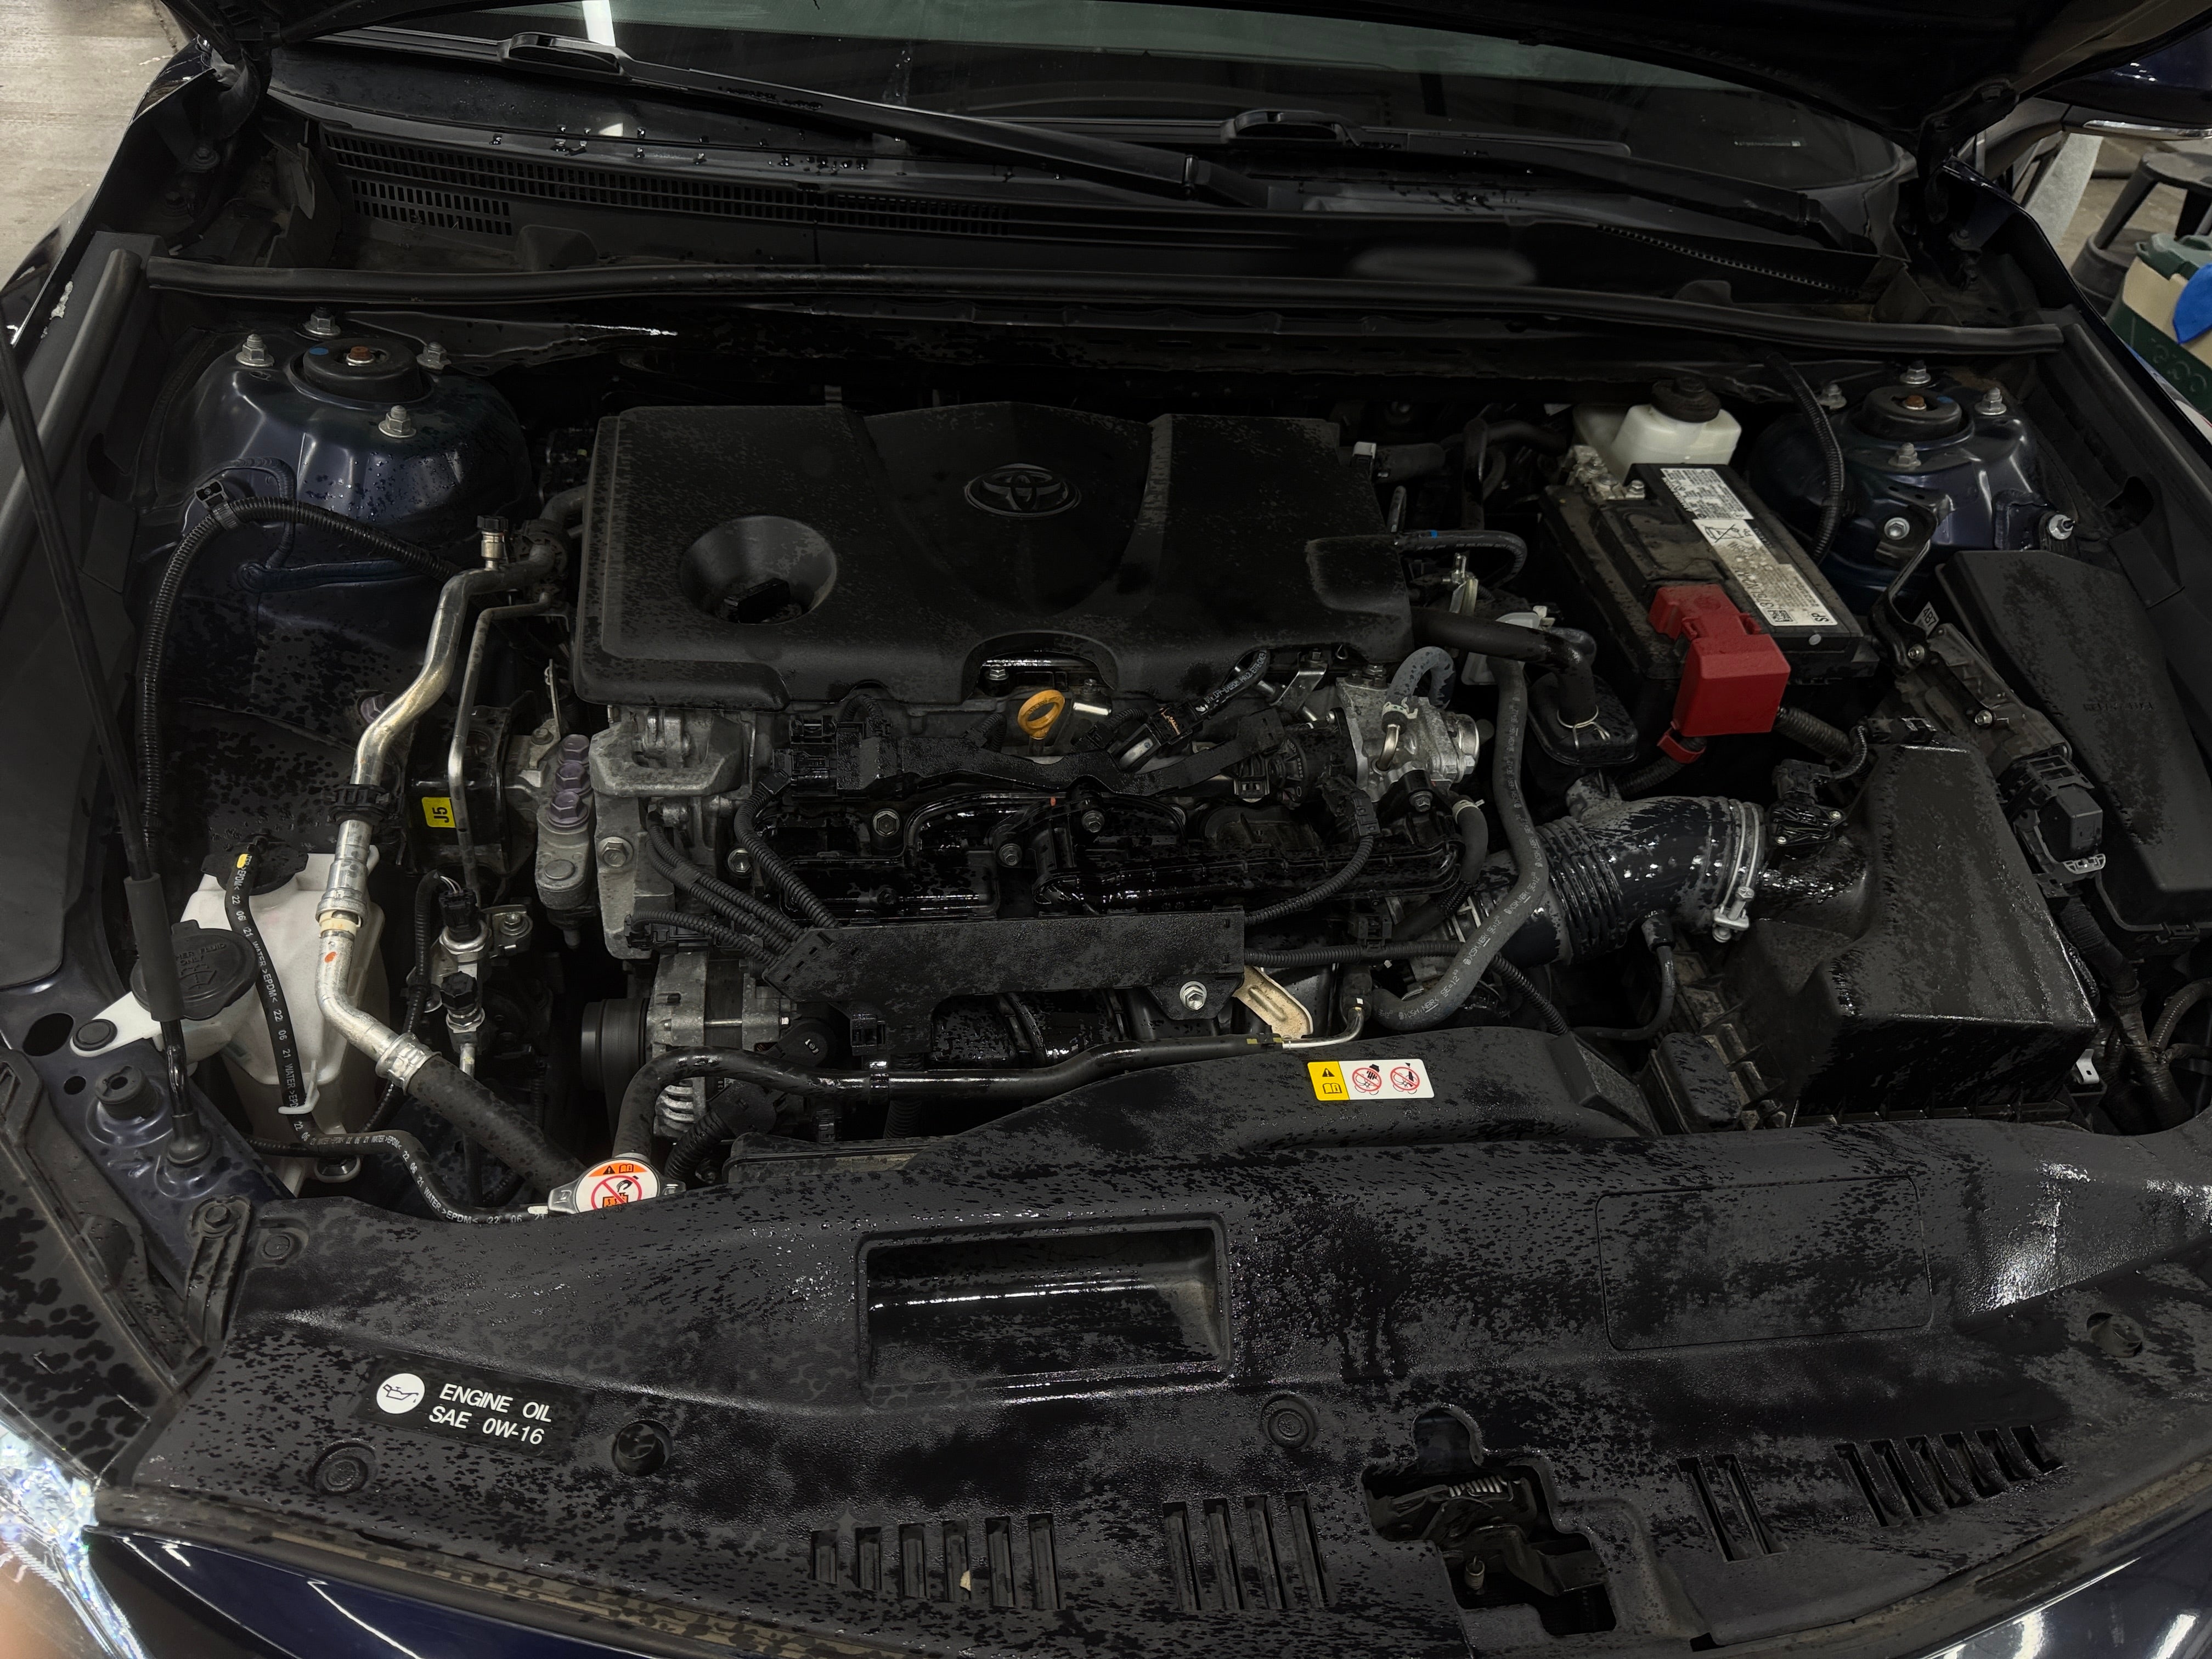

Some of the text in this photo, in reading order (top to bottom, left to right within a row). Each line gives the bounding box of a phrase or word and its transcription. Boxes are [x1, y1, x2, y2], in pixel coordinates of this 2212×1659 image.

[1811, 612, 1830, 622] SP
[1923, 608, 1937, 627] 4B7
[432, 806, 450, 823] J5
[231, 895, 241, 905] 22
[235, 910, 247, 922] 06
[242, 927, 254, 938] 21
[199, 943, 227, 953] FLUID
[252, 940, 267, 967] WATER
[179, 955, 204, 966] ONLY
[272, 1009, 284, 1022] 22
[278, 1029, 288, 1041] 06
[281, 1048, 292, 1059] 21
[284, 1063, 296, 1090] WATER
[288, 1090, 300, 1108] >EPD
[294, 1120, 304, 1132] 22
[301, 1131, 311, 1142] 06
[402, 1150, 410, 1163] 22
[409, 1161, 418, 1175] 06
[416, 1175, 425, 1188] 21
[424, 1186, 442, 1212] WATER
[441, 1207, 479, 1224] >EPDM<
[487, 1216, 501, 1224] 22
[439, 1383, 552, 1423] ENGINE OIL
[428, 1406, 545, 1445] SAE 0W-16
